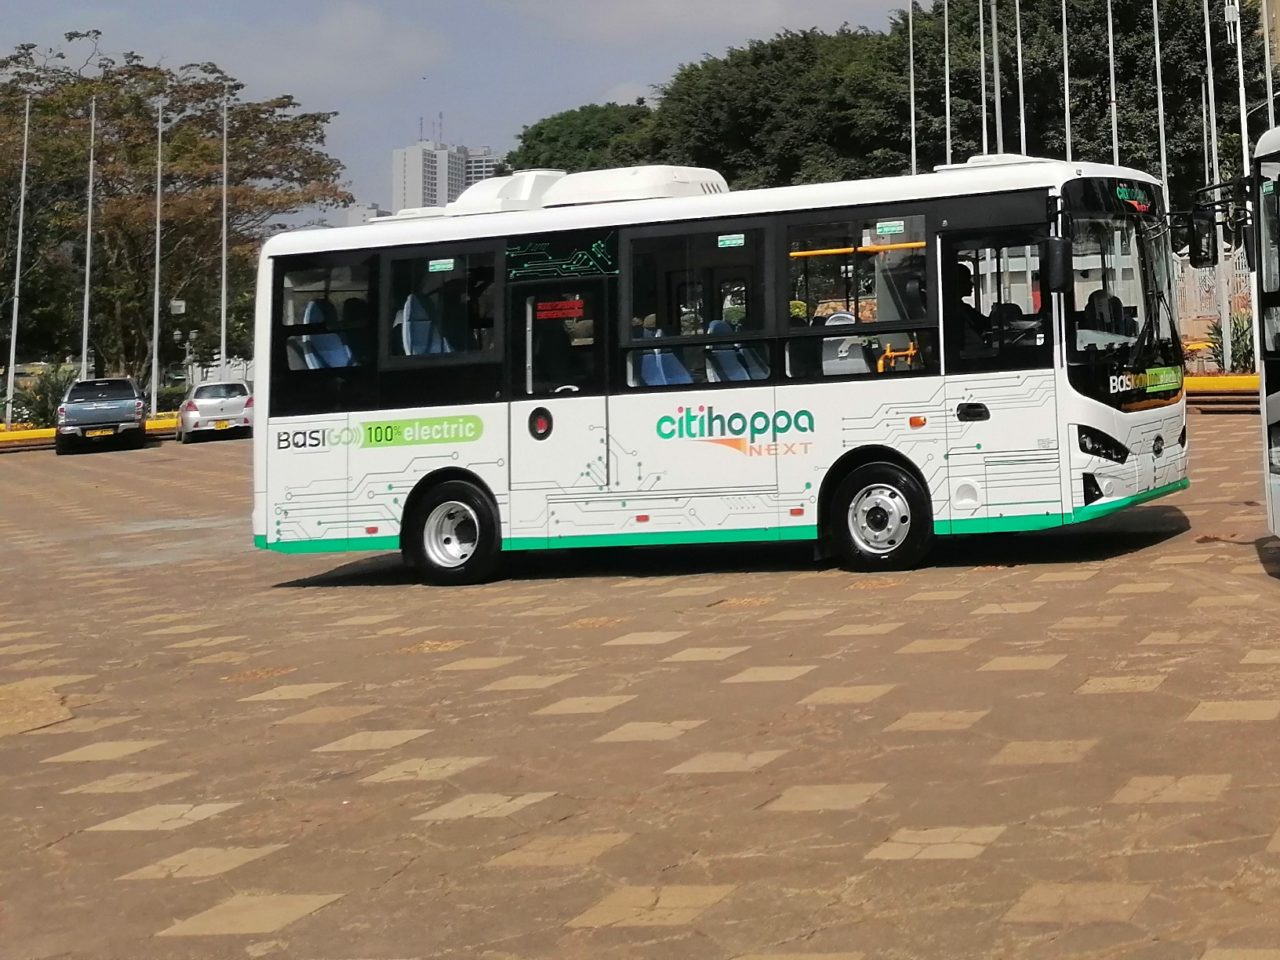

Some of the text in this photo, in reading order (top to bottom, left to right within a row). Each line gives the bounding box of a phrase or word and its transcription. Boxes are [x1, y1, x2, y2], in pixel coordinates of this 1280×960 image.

[367, 424, 401, 443] 100%
[404, 417, 477, 441] electric
[656, 404, 815, 444] citihoppa
[750, 442, 813, 457] NEXT
